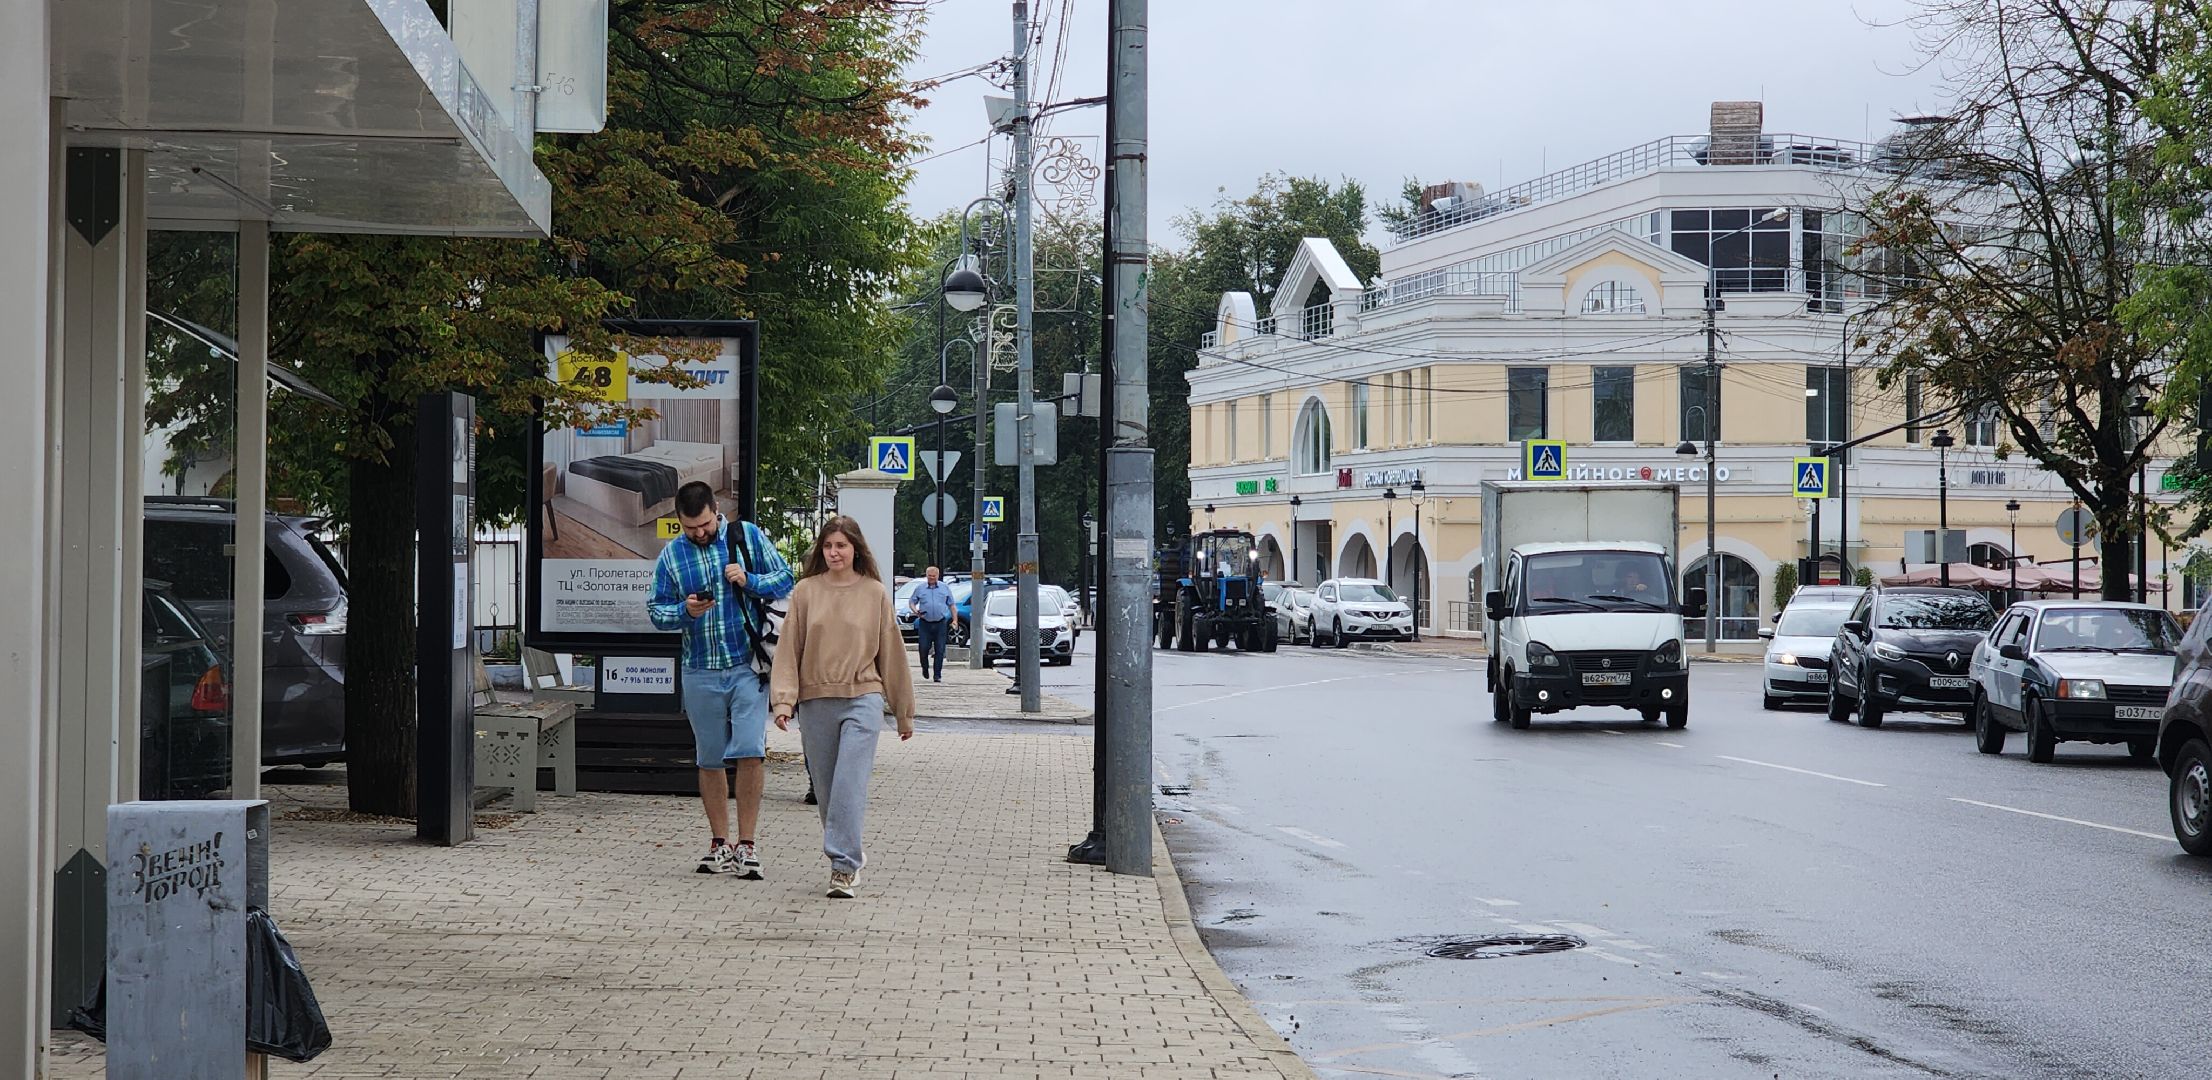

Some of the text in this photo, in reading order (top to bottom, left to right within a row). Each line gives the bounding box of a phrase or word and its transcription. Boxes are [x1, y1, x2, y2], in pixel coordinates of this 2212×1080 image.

[575, 367, 611, 387] 48
[570, 568, 654, 579] ул. Пролетарск
[558, 581, 652, 593] ТЦ «Золотая вер
[605, 668, 618, 680] 16
